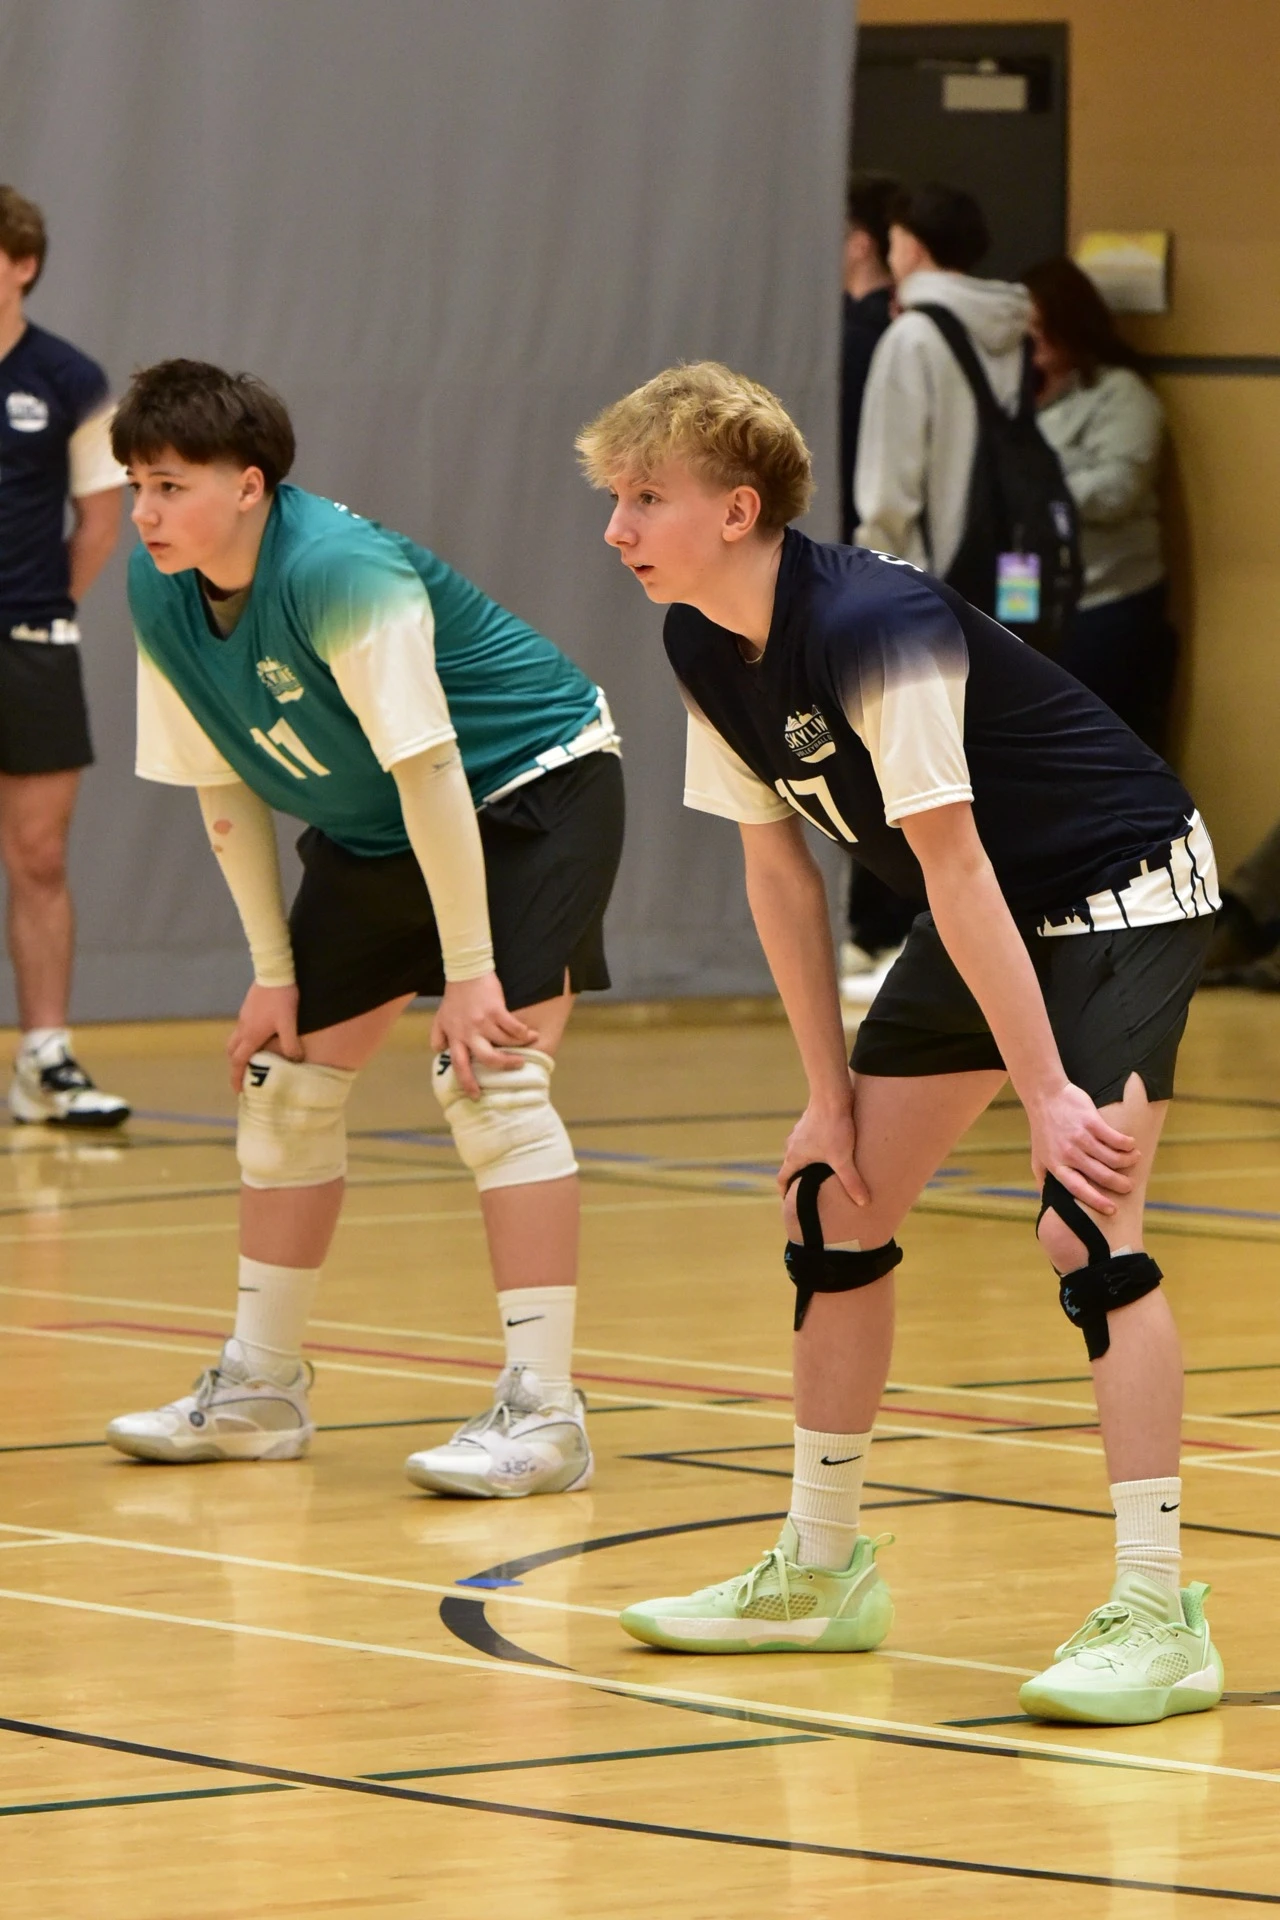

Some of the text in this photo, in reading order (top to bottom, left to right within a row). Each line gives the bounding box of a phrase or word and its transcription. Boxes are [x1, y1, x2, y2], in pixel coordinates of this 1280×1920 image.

[249, 716, 331, 779] 11
[785, 714, 828, 749] SKYLIN
[774, 775, 859, 843] 17
